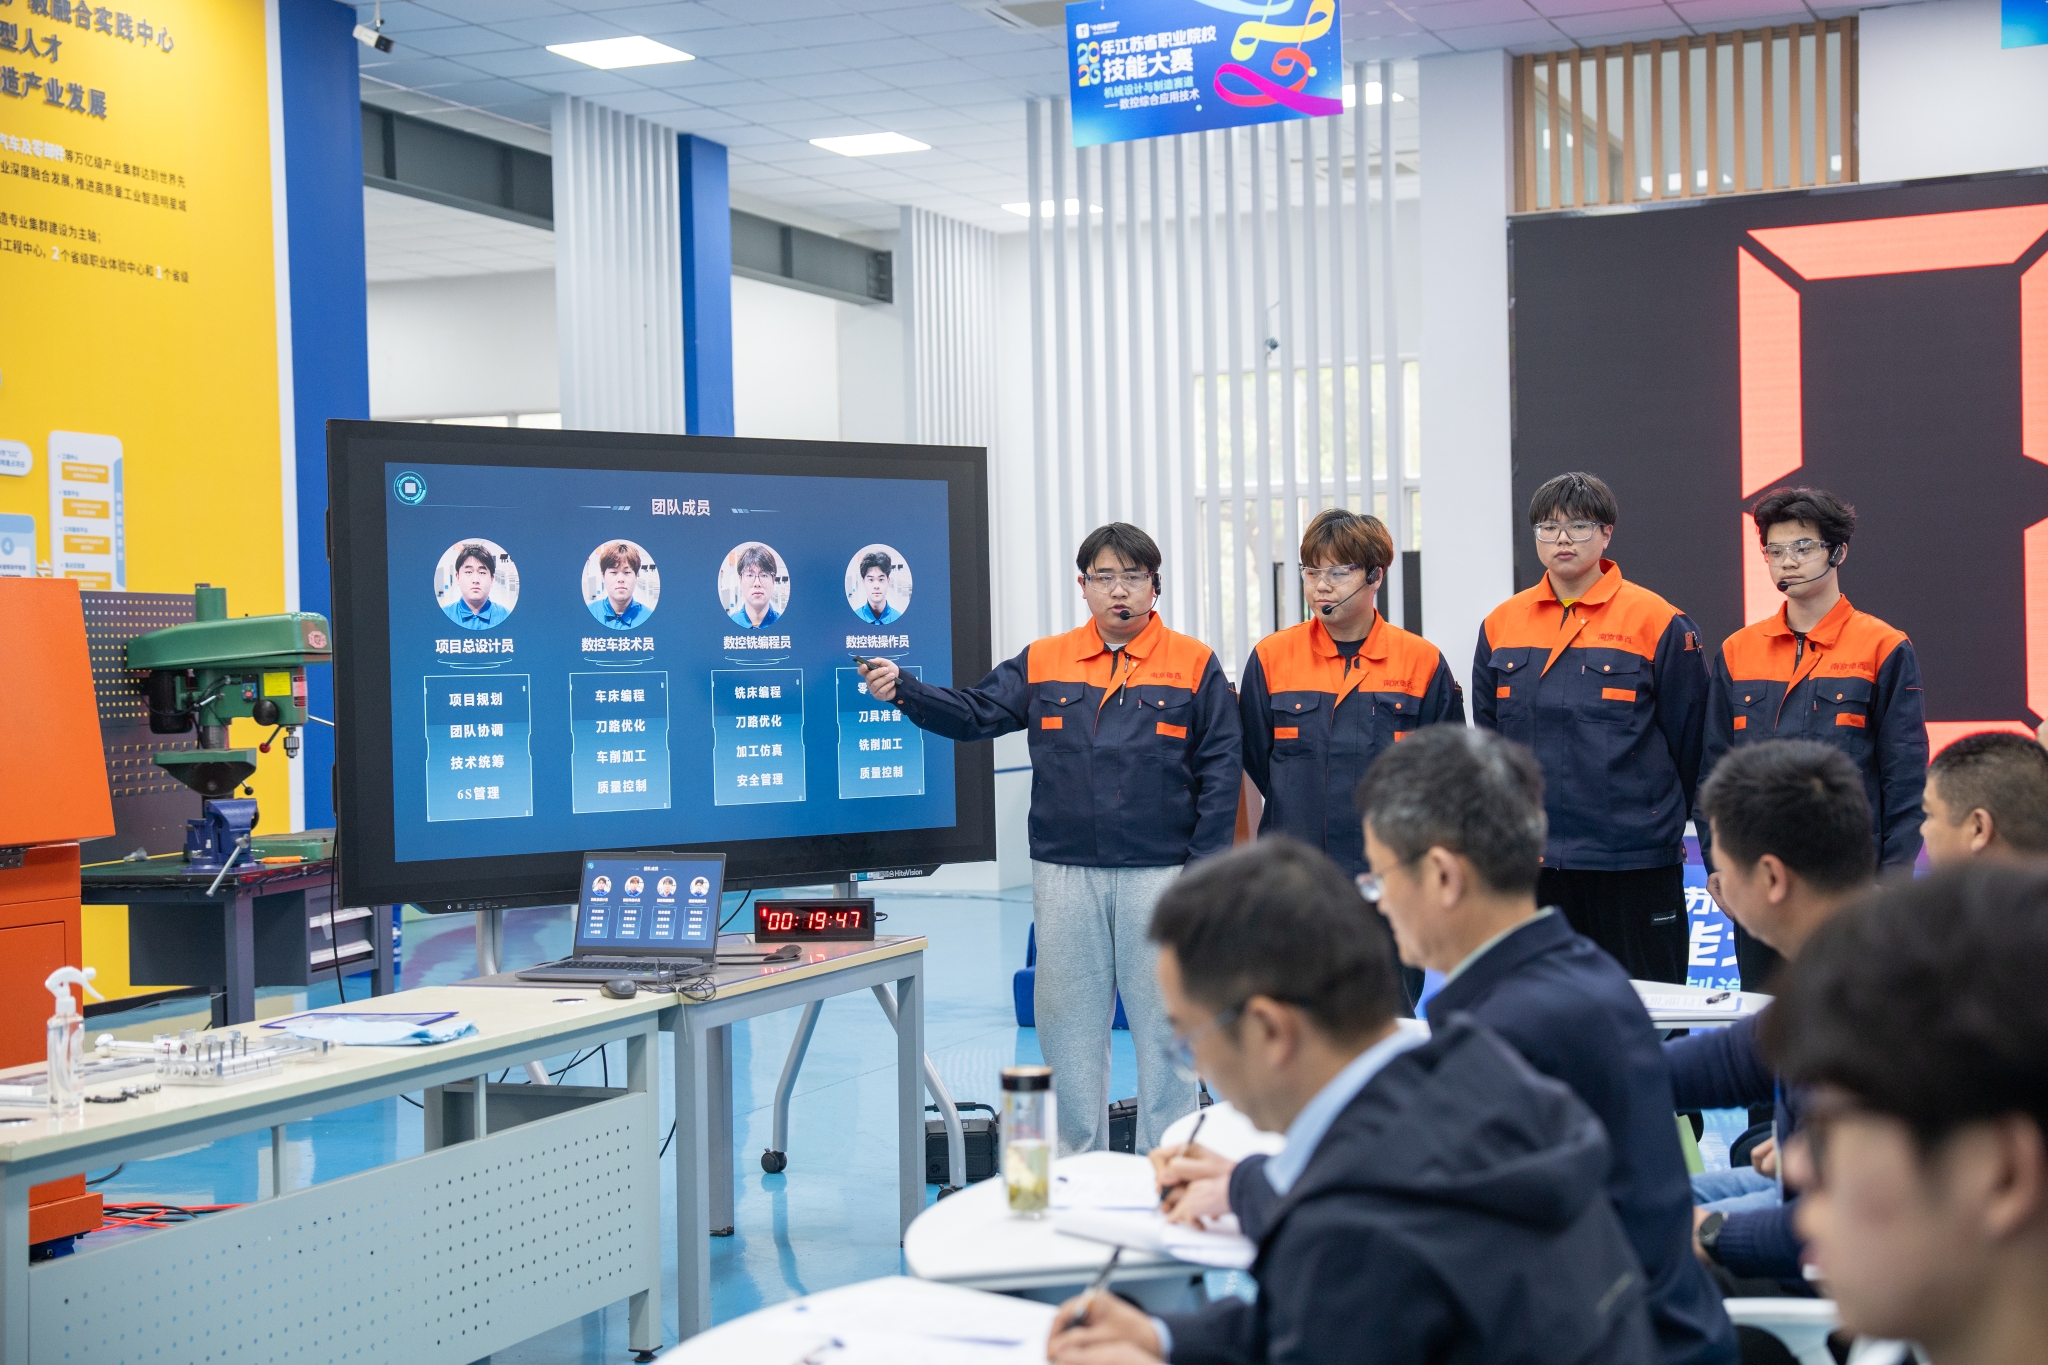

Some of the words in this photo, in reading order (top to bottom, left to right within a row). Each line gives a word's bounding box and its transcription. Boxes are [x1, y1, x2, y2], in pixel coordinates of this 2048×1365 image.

[0, 0, 174, 53] 教融合实践中心
[1100, 25, 1217, 56] 年江苏省职业院校
[1102, 47, 1194, 84] 技能大赛
[0, 65, 107, 119] 造产业发展
[1103, 75, 1194, 99] 机械设计与制造赛道
[651, 498, 711, 516] 团队成员
[435, 638, 514, 654] 项目总设计员
[581, 637, 655, 652] 数控车技术员
[723, 635, 792, 650] 数控铣编程员
[845, 634, 910, 649] 数控铣操作员
[449, 692, 503, 707] 项目规划
[595, 688, 646, 703] 车床编程
[734, 685, 782, 700] 铣床编程
[735, 714, 782, 729] 刀路优化
[858, 709, 902, 723] 刀具准备
[450, 723, 504, 739] 团队协调
[595, 719, 646, 734] 刀路优化
[736, 743, 783, 758] 加工仿真
[858, 738, 903, 751] 铣削加工
[450, 754, 505, 770] 技术统筹
[596, 749, 647, 764] 车削加工
[860, 765, 904, 779] 质量控制
[597, 779, 647, 794] 质量控制
[737, 773, 784, 787] 安全管理
[457, 786, 500, 801] 6S管理
[894, 868, 923, 877] HiteVision
[767, 911, 861, 931] 00:19:47
